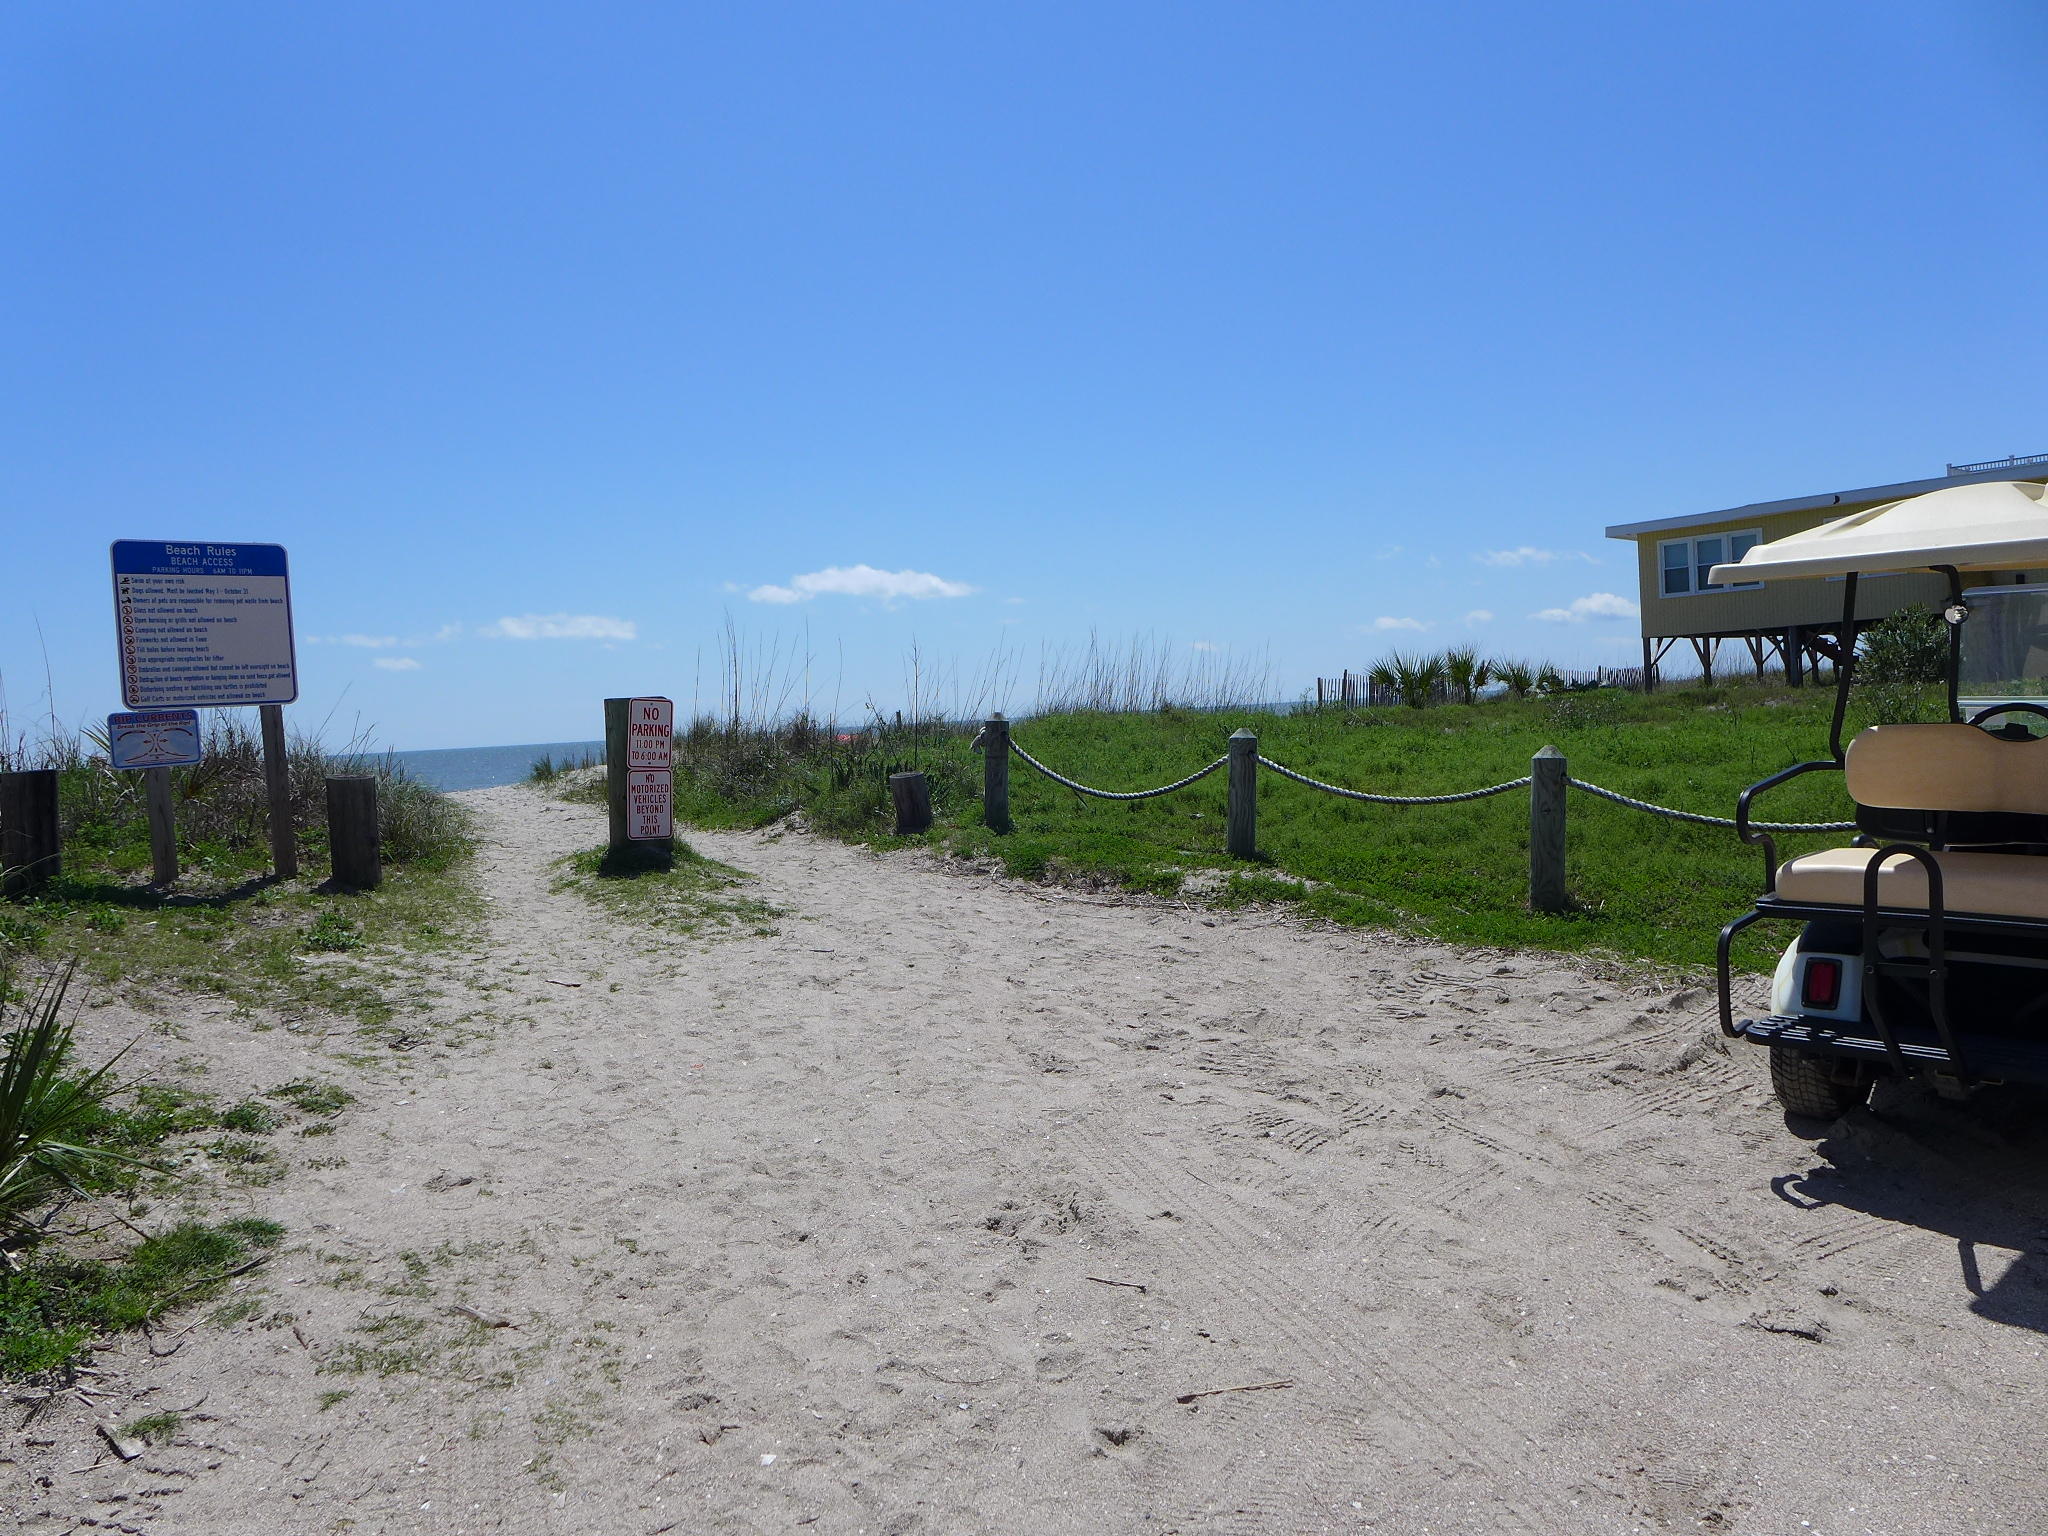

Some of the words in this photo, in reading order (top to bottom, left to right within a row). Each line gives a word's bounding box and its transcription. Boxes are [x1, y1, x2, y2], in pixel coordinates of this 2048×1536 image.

[166, 544, 200, 555] Beach
[207, 546, 237, 556] Rules
[171, 557, 198, 566] BEACH
[202, 558, 234, 566] ACCESS
[136, 712, 192, 722] CURRENTS
[644, 708, 659, 720] NO
[632, 724, 669, 737] PARKING
[636, 740, 652, 748] 11:00
[656, 740, 665, 749] PM
[632, 751, 639, 760] TO
[641, 752, 656, 760] 6:00
[658, 752, 668, 760] AM
[646, 774, 654, 783] NO
[632, 784, 669, 794] MOTORIZED
[634, 794, 666, 804] VEHICLES
[636, 805, 664, 814] BEYOND
[643, 815, 658, 824] THIS
[640, 825, 660, 835] POINT
